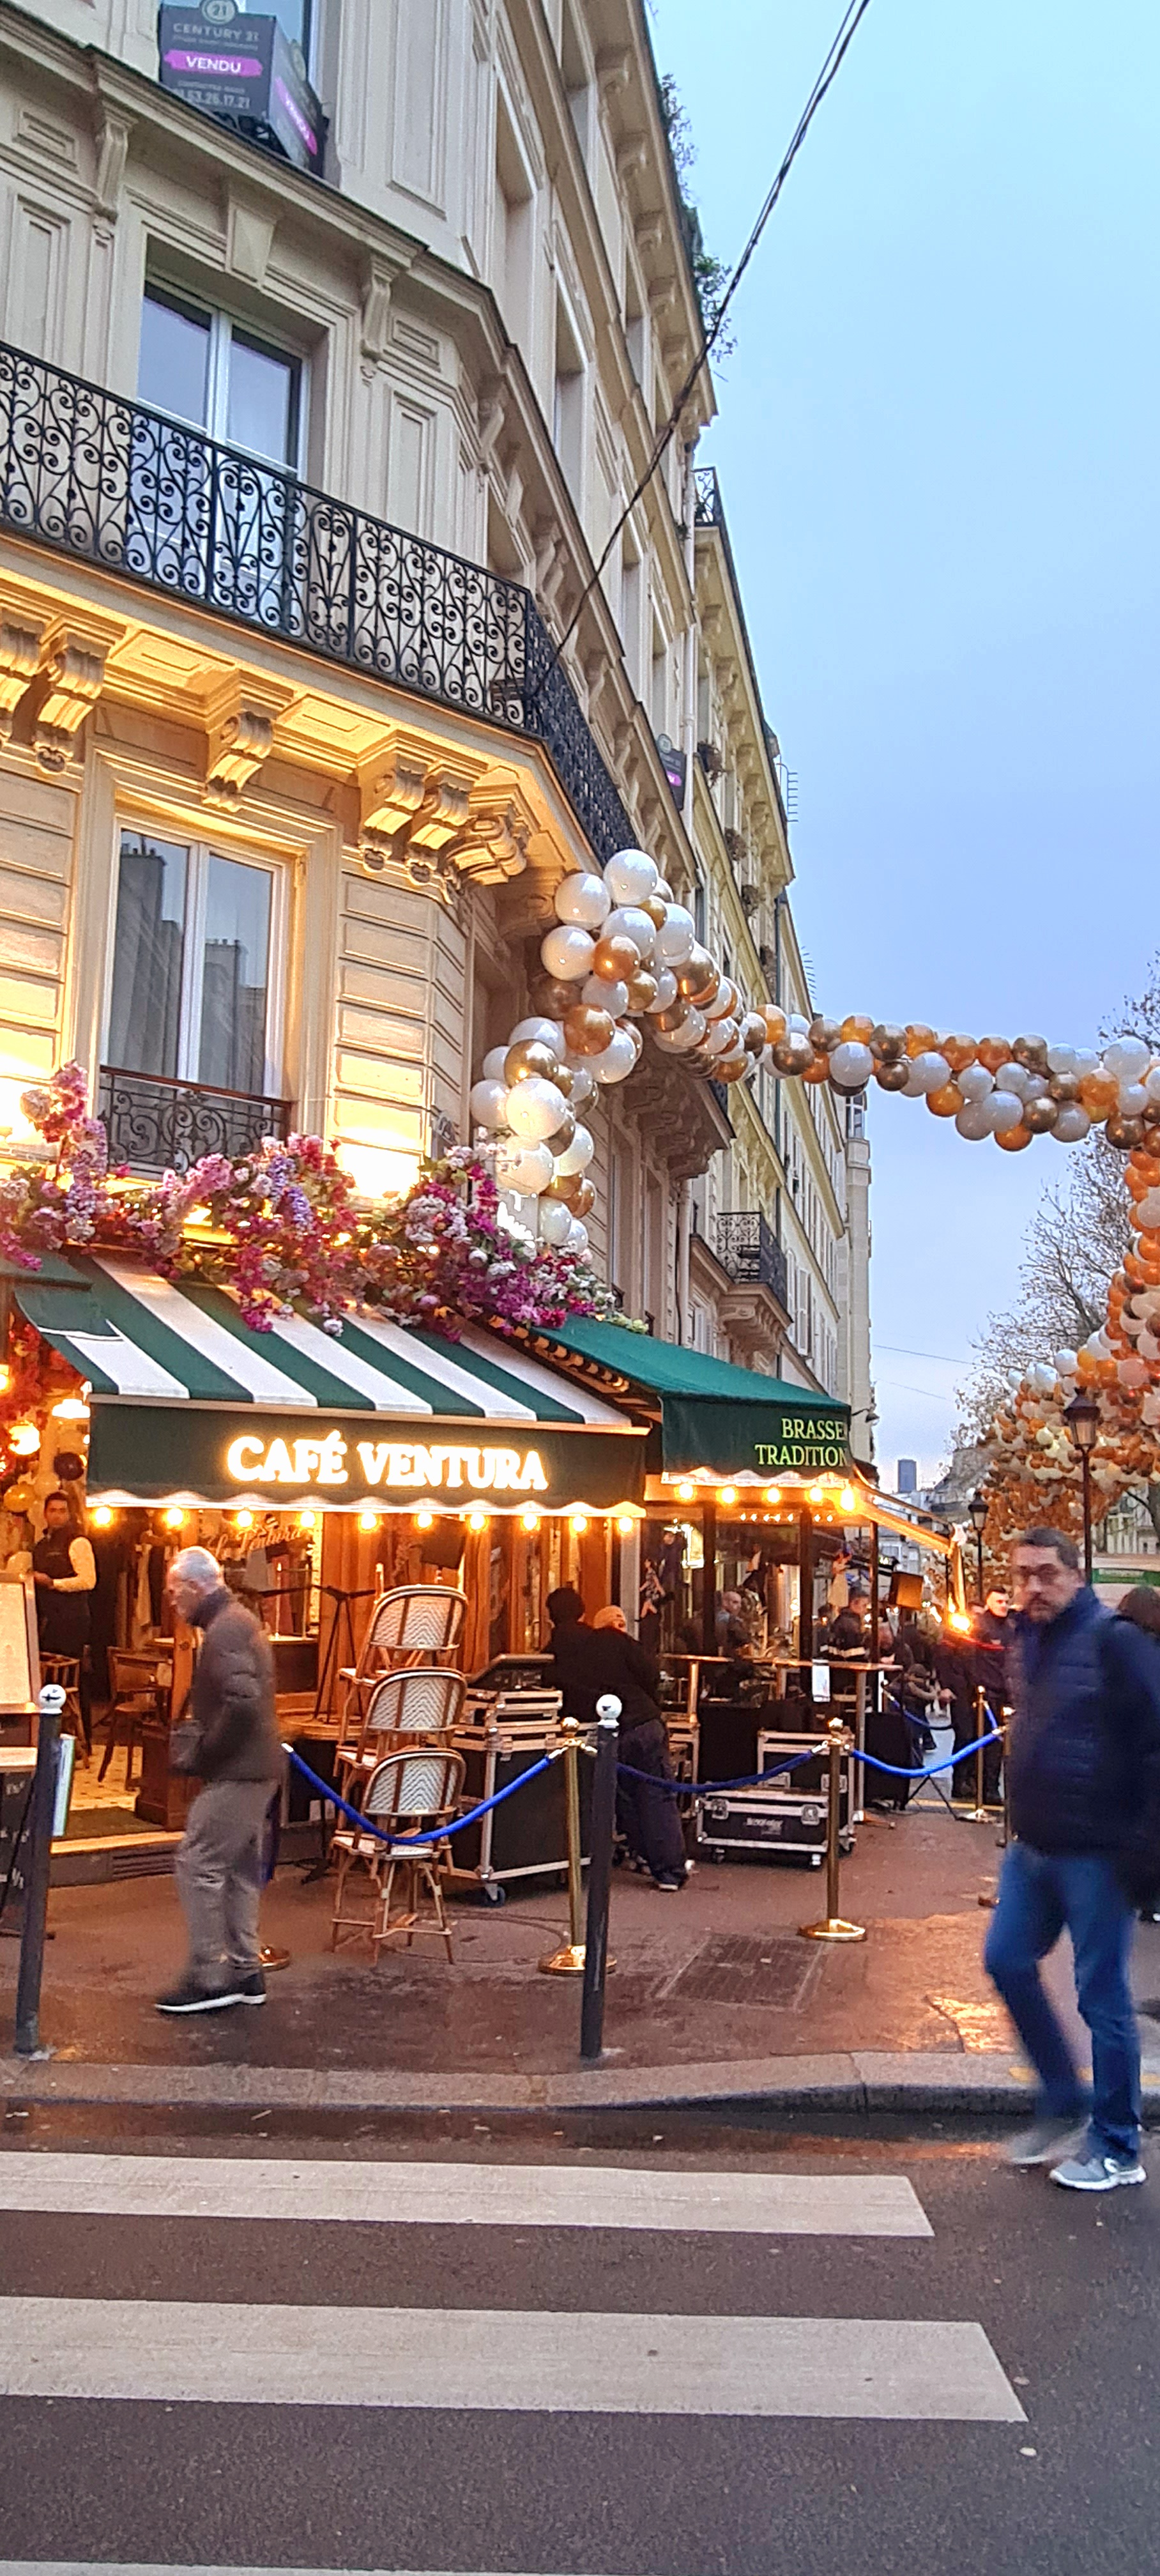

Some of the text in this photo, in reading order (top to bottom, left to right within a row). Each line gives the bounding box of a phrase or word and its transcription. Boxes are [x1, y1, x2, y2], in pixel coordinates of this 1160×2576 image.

[173, 22, 242, 40] CENTURY
[186, 56, 241, 74] VENDU
[227, 1429, 549, 1491] CAFÉ VENTURA
